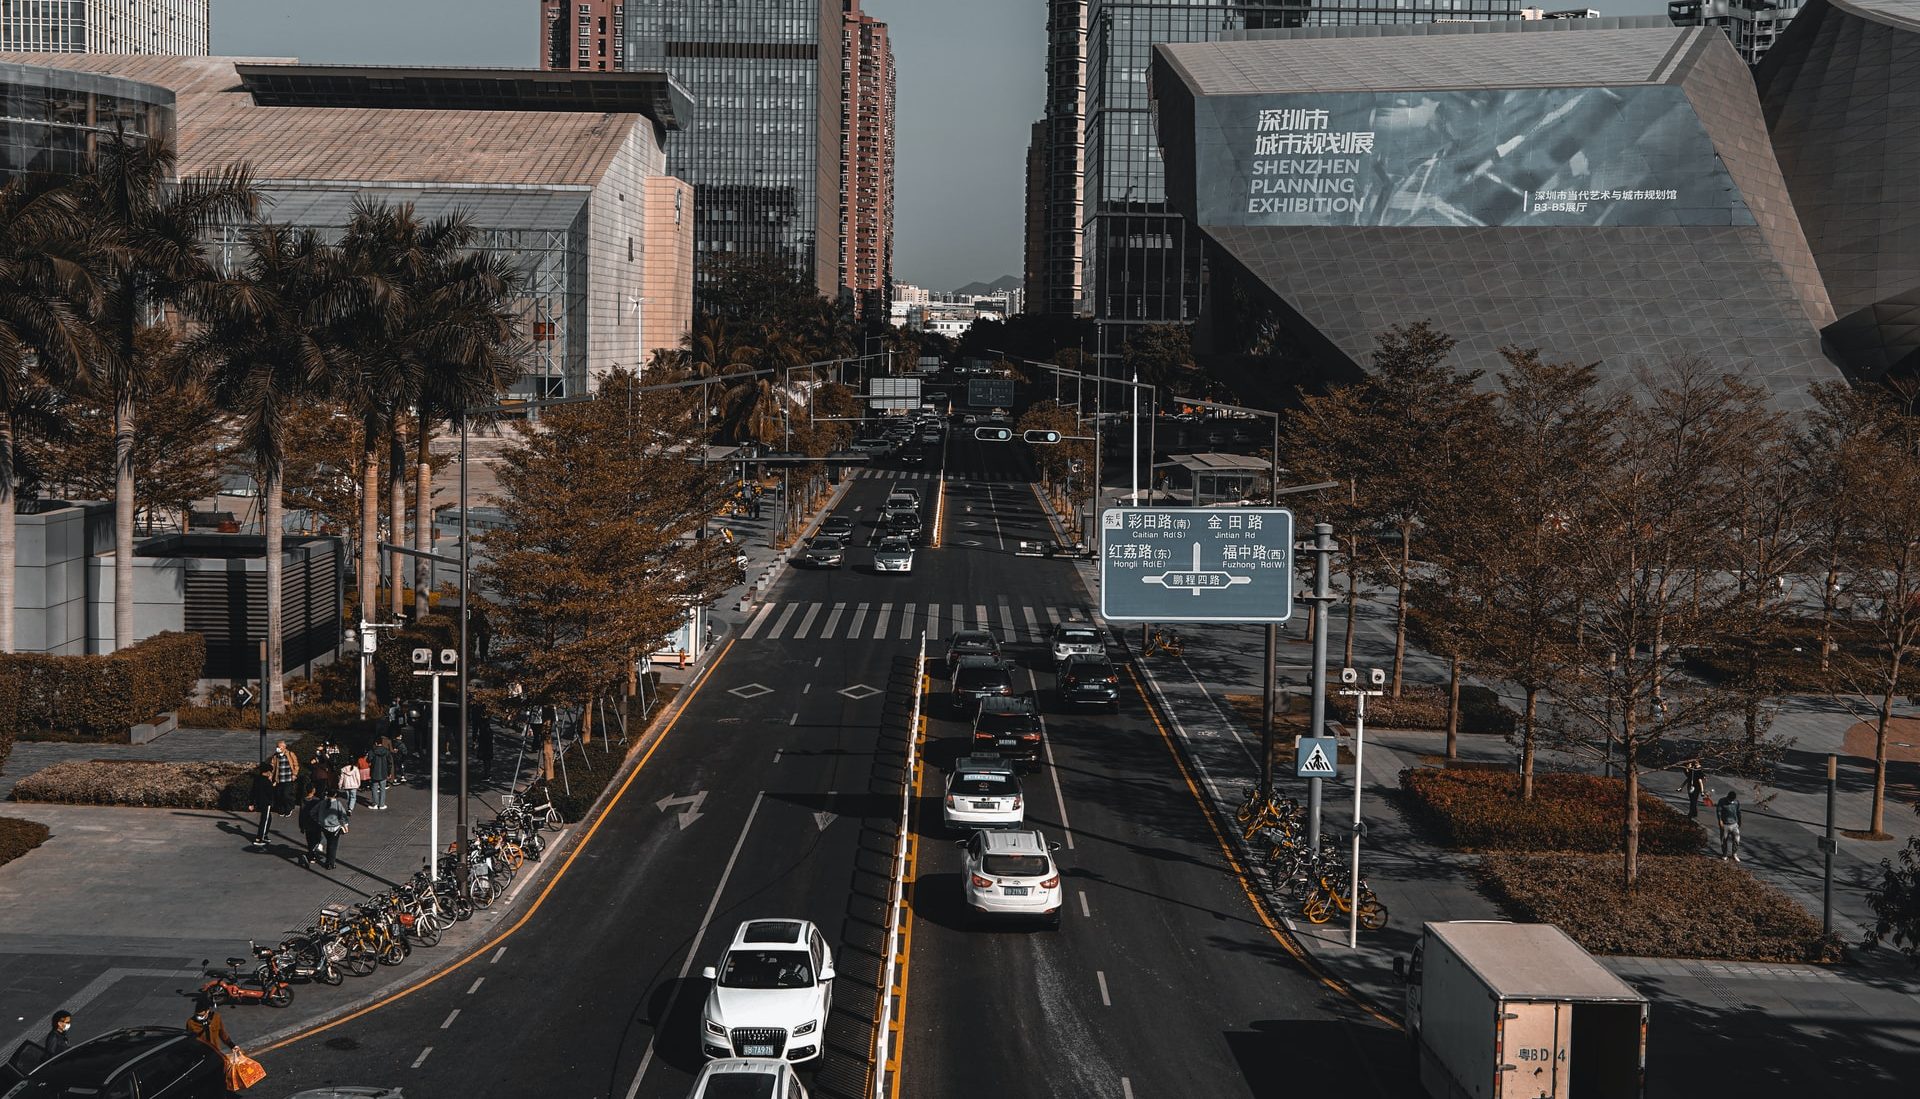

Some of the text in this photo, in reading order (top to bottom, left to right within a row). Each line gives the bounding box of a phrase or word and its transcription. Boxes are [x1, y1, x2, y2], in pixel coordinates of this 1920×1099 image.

[1257, 109, 1329, 131] 深圳市
[1254, 132, 1375, 155] 城市规划展
[1252, 159, 1360, 174] SHENZHEN
[1250, 178, 1354, 194] PLANNING
[1535, 189, 1677, 201] 深圳市当代艺术与城市规划馆
[1248, 198, 1366, 213] EXHIBITION
[1534, 202, 1588, 213] B3-B5展厅
[1105, 515, 1114, 524] 东
[1207, 514, 1263, 530] 金田路
[1163, 531, 1186, 539] Rd(S)
[1113, 561, 1138, 569] Hongli
[1222, 561, 1285, 569] Fuzhong Rd(W)
[1173, 574, 1220, 585] 鹏程四路
